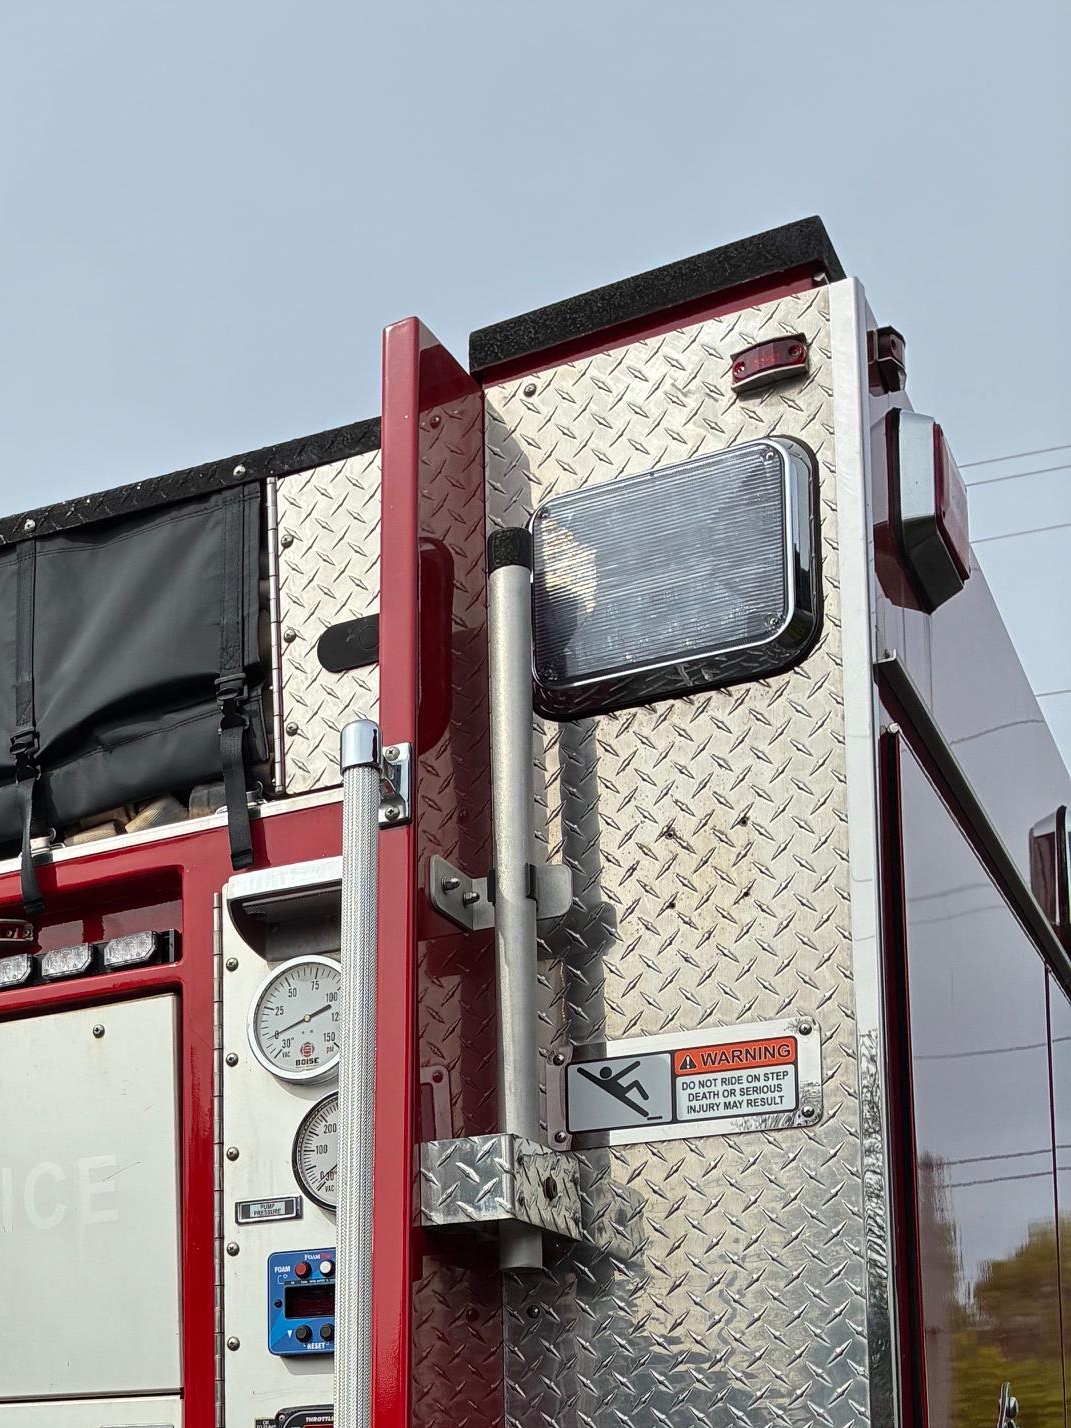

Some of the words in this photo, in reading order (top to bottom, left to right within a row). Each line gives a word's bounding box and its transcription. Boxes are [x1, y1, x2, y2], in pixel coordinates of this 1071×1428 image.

[312, 981, 320, 991] 75
[288, 988, 297, 998] 50
[326, 992, 338, 1002] 100
[275, 1006, 284, 1016] 25
[324, 1032, 336, 1042] 150
[700, 1042, 791, 1067] WARNING
[295, 1057, 320, 1066] BOISE
[682, 1081, 696, 1092] DO
[698, 1078, 718, 1090] NOT
[720, 1075, 744, 1088] RIDE
[746, 1074, 760, 1085] ON
[763, 1070, 789, 1084] STEP
[688, 1090, 719, 1102] DEATH
[722, 1088, 736, 1099] OR
[739, 1083, 783, 1098] SERIOUS
[686, 1103, 720, 1115] INJURY
[723, 1100, 744, 1112] MAY
[747, 1095, 784, 1110] RESULT
[323, 1123, 336, 1134] 200
[316, 1145, 328, 1154] 100
